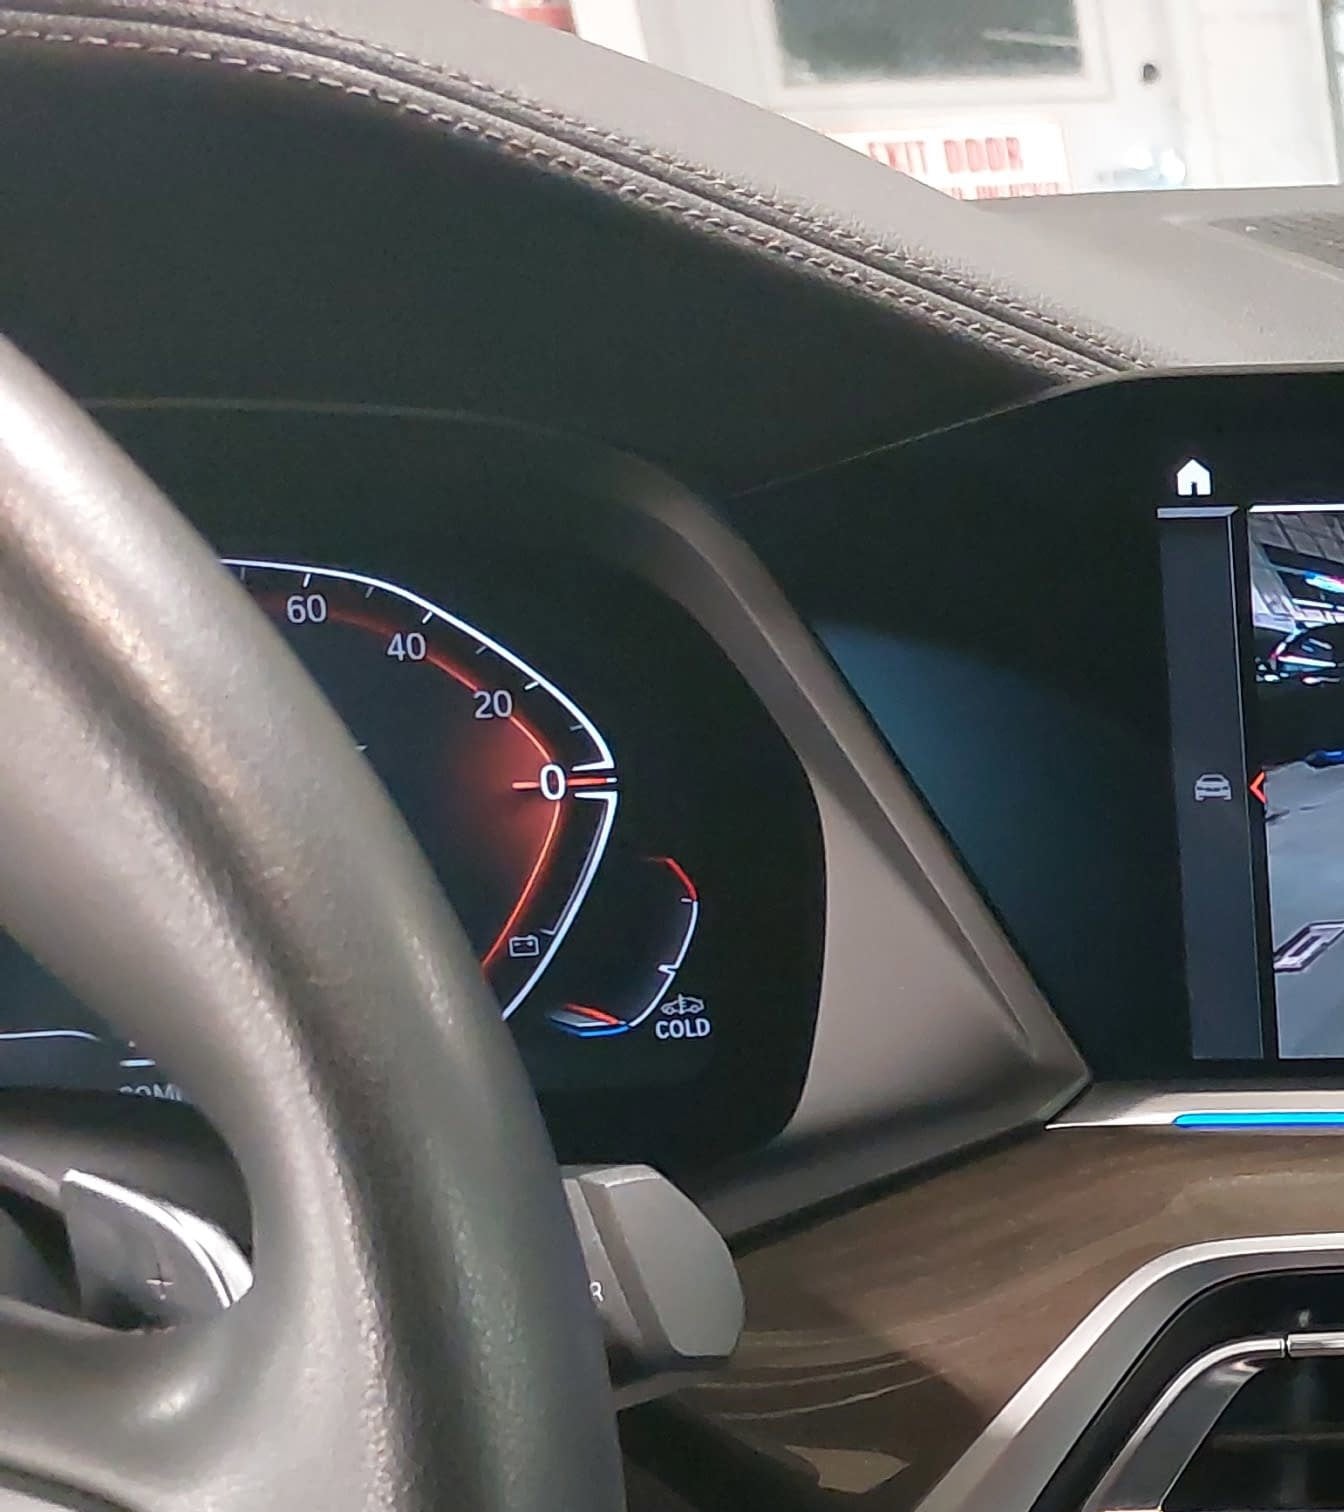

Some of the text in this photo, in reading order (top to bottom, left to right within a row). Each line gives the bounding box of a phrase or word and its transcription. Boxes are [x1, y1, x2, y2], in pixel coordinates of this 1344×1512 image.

[943, 136, 1023, 173] DOOR
[286, 594, 327, 624] 60
[387, 633, 427, 662] 40
[473, 690, 513, 719] 20
[539, 763, 567, 802] 0
[654, 1016, 711, 1040] COLD
